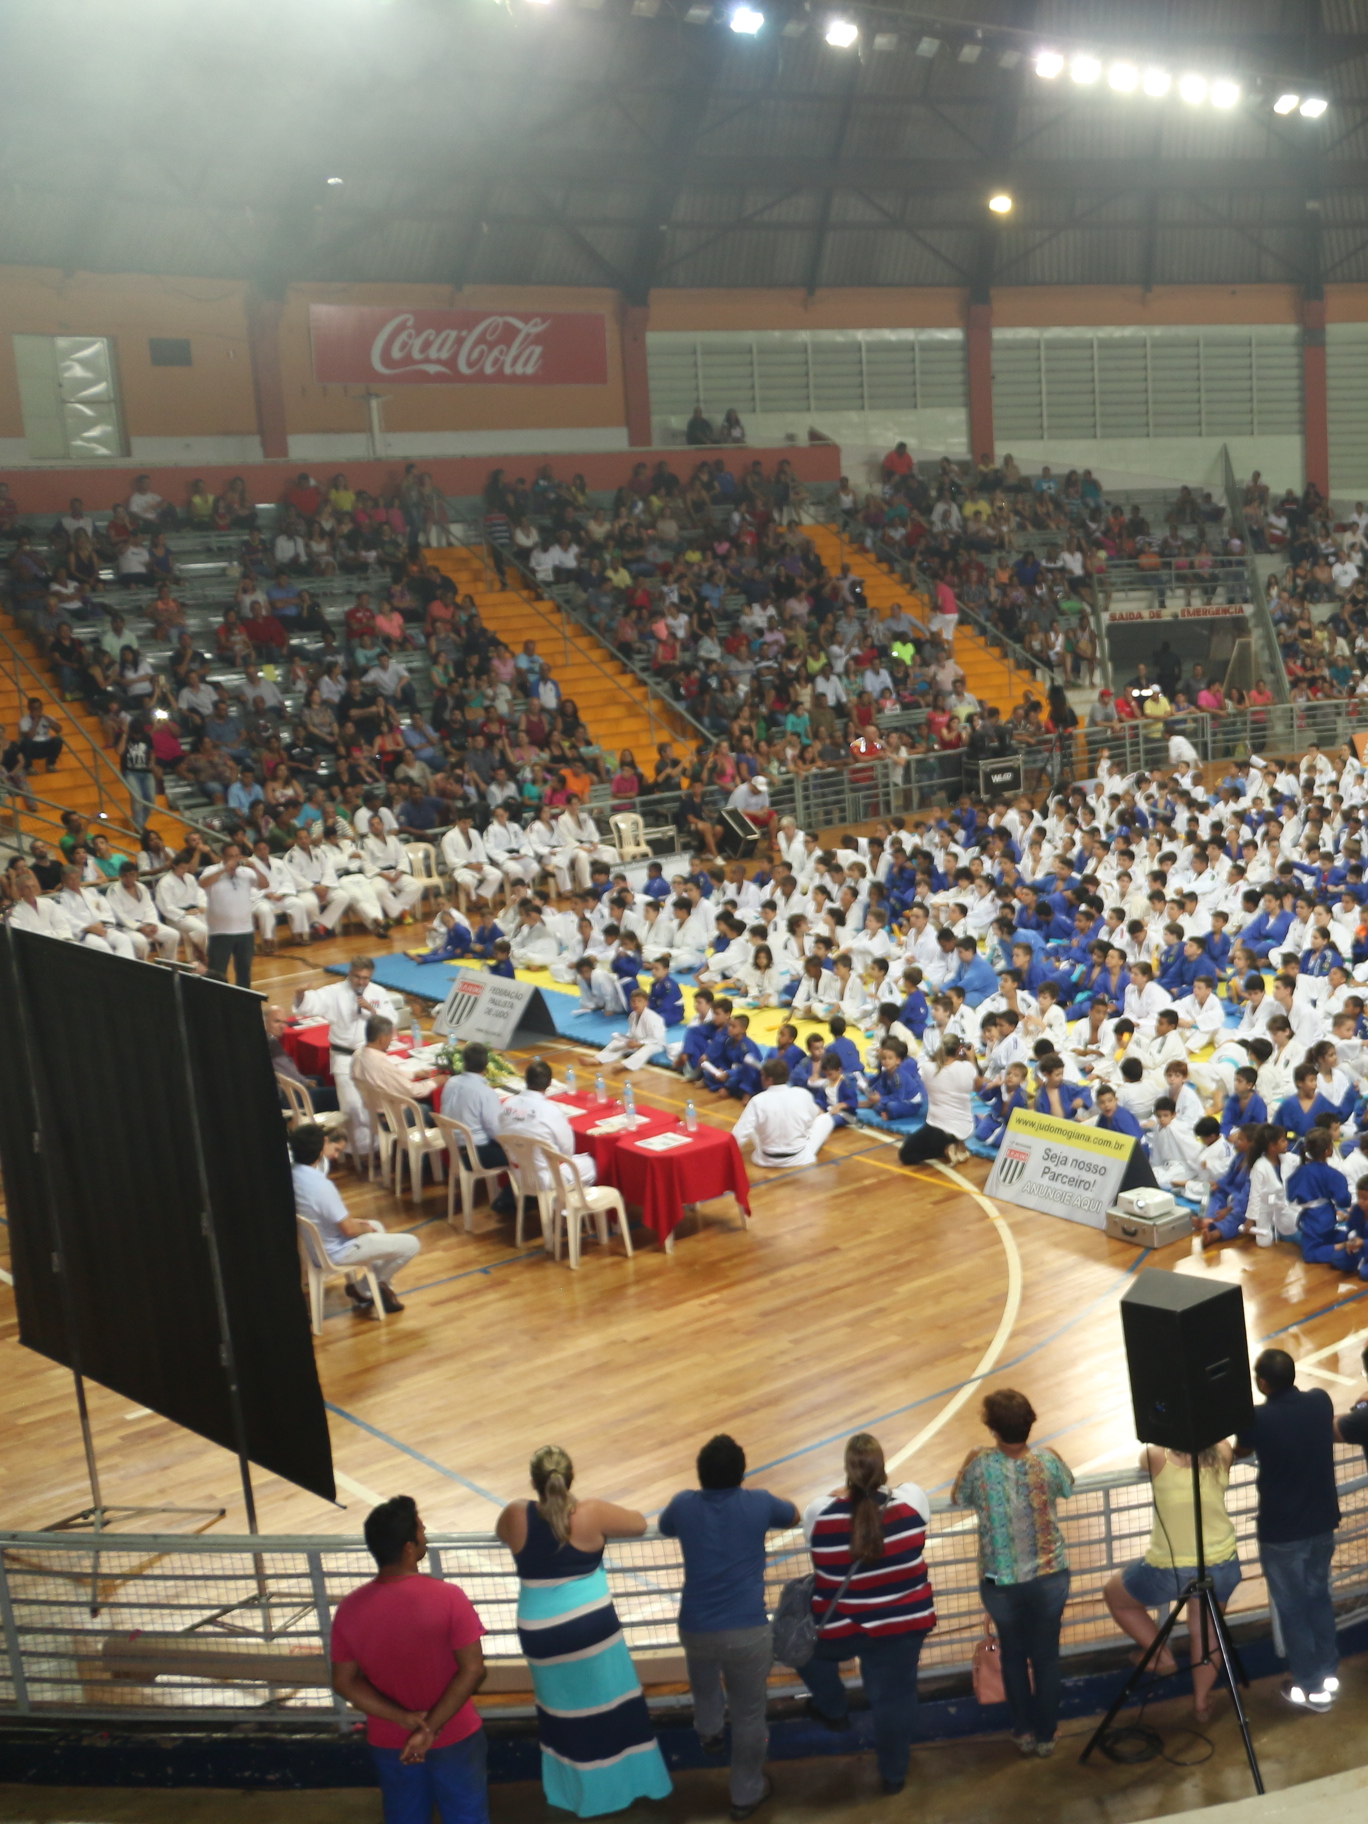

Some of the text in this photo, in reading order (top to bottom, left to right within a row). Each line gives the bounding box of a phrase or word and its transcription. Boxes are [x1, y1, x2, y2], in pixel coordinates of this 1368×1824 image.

[370, 313, 551, 375] Coca-Cola
[1149, 610, 1162, 619] DE
[489, 986, 524, 1001] FEDERAÇÃO
[1015, 1115, 1124, 1151] www.judomogiana.com.br
[1042, 1147, 1107, 1176] Seja nosso
[1041, 1166, 1097, 1192] Parceiro!
[1022, 1181, 1103, 1214] ANUNCIE AQUI
